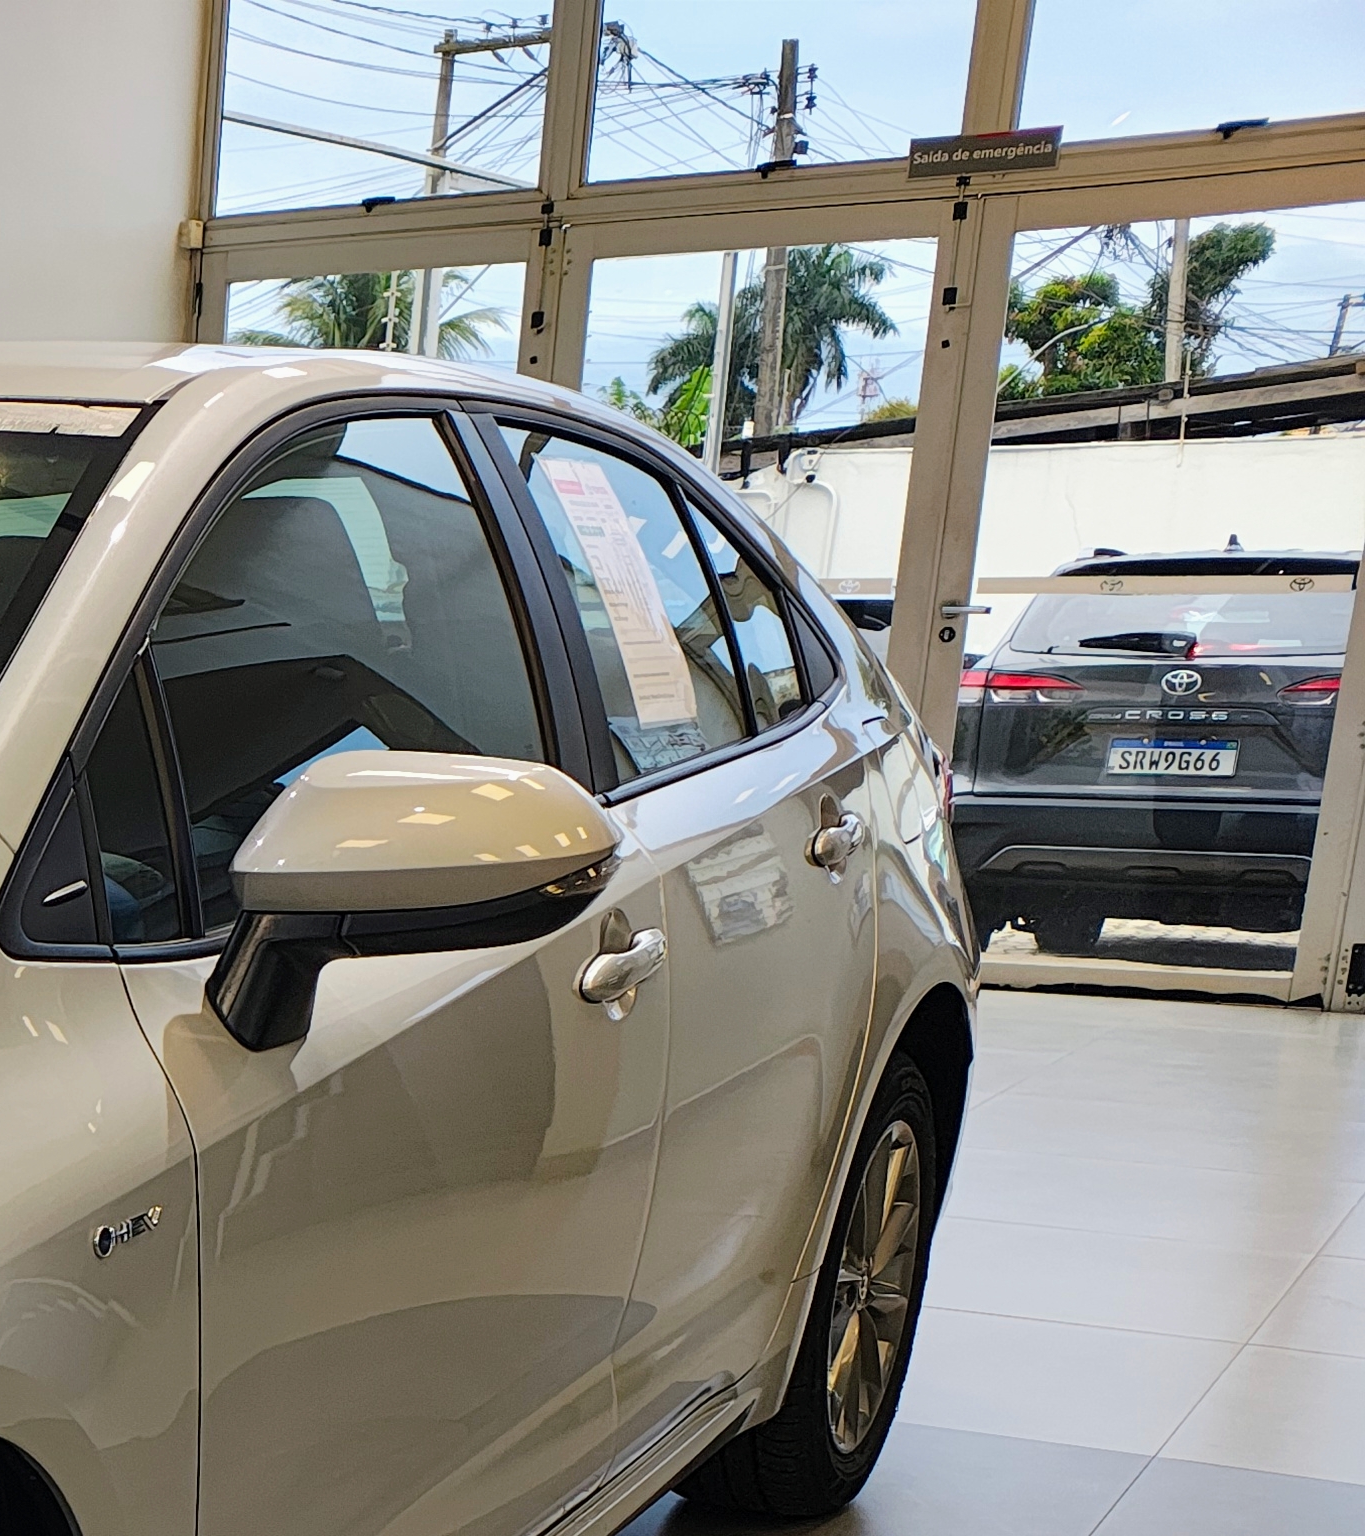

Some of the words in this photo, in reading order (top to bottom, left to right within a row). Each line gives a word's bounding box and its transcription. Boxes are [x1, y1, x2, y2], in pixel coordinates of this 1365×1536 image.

[913, 150, 949, 164] Saída
[952, 148, 969, 161] de
[973, 141, 1053, 159] emergência
[1119, 750, 1222, 772] SRW9G66
